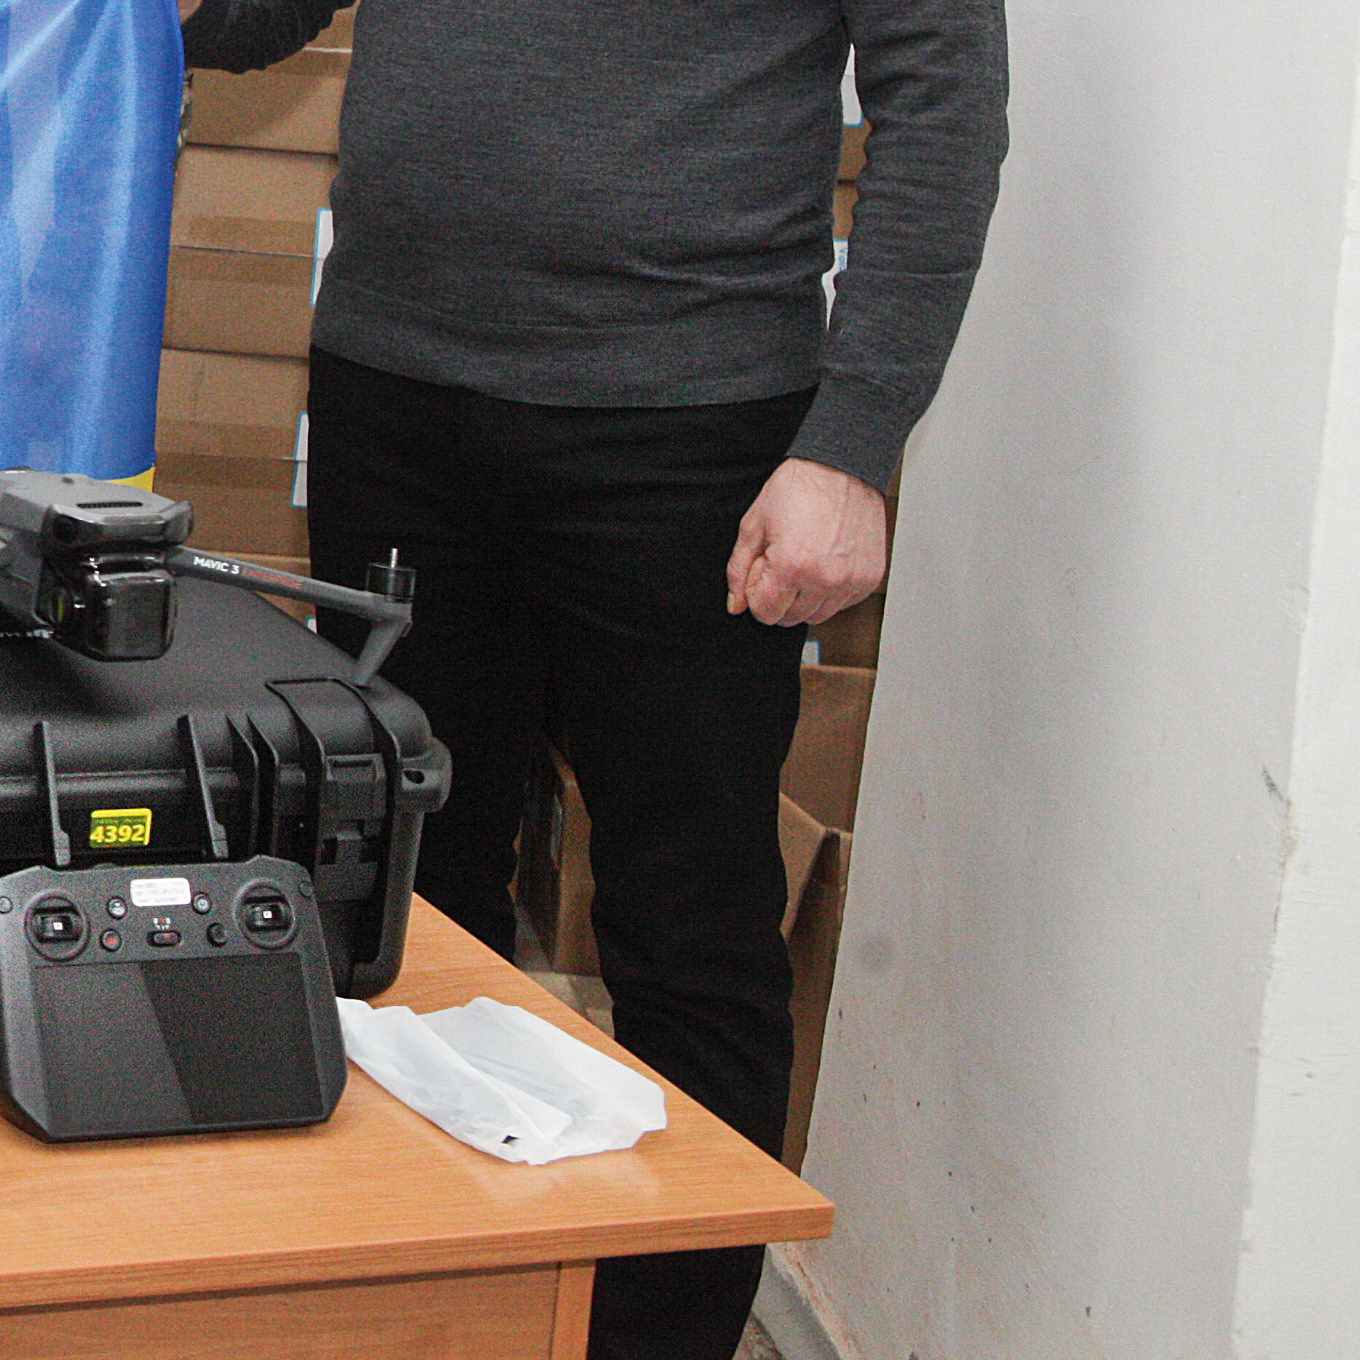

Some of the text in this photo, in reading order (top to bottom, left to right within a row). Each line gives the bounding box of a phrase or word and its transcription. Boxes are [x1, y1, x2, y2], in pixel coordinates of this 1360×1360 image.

[192, 556, 230, 572] MAVIC
[230, 564, 240, 575] 3
[90, 824, 145, 843] 4392
